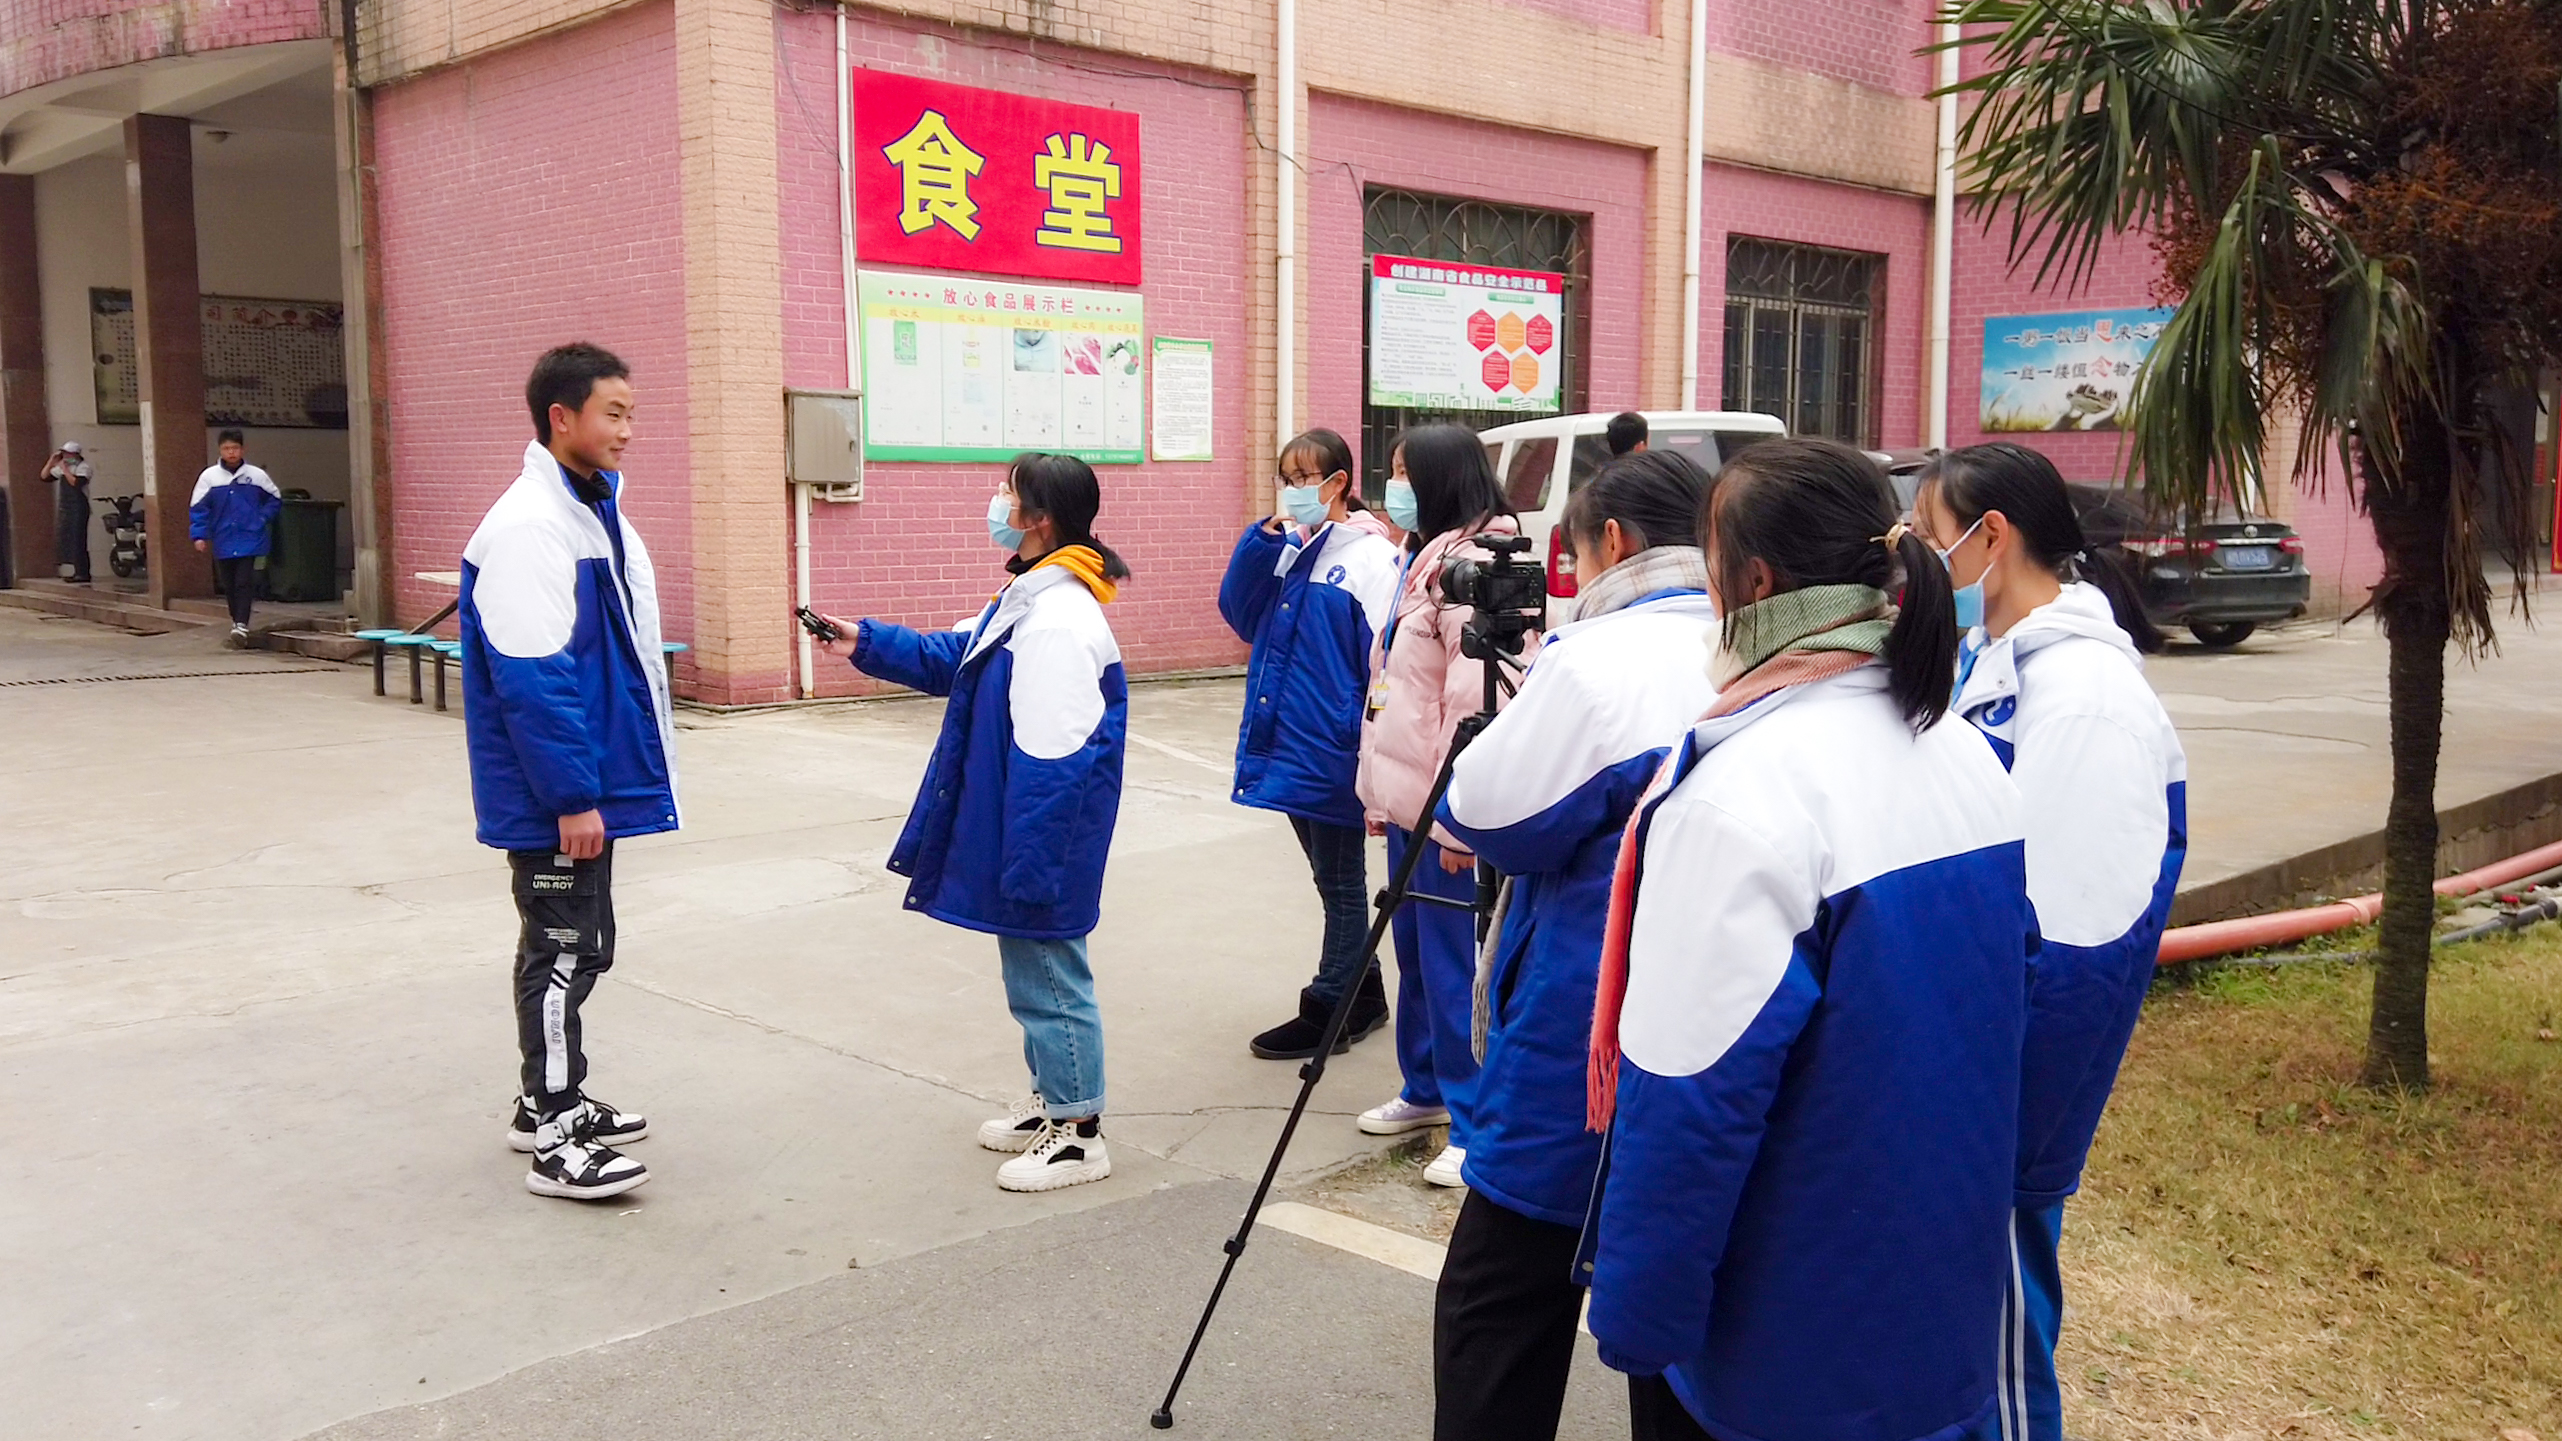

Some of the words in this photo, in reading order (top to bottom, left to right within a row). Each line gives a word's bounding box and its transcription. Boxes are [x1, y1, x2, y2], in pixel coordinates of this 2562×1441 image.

[882, 108, 1122, 254] 食堂
[1390, 263, 1547, 292] 创建湖南省食品安全示范县
[943, 287, 1075, 314] 放心食品展示栏
